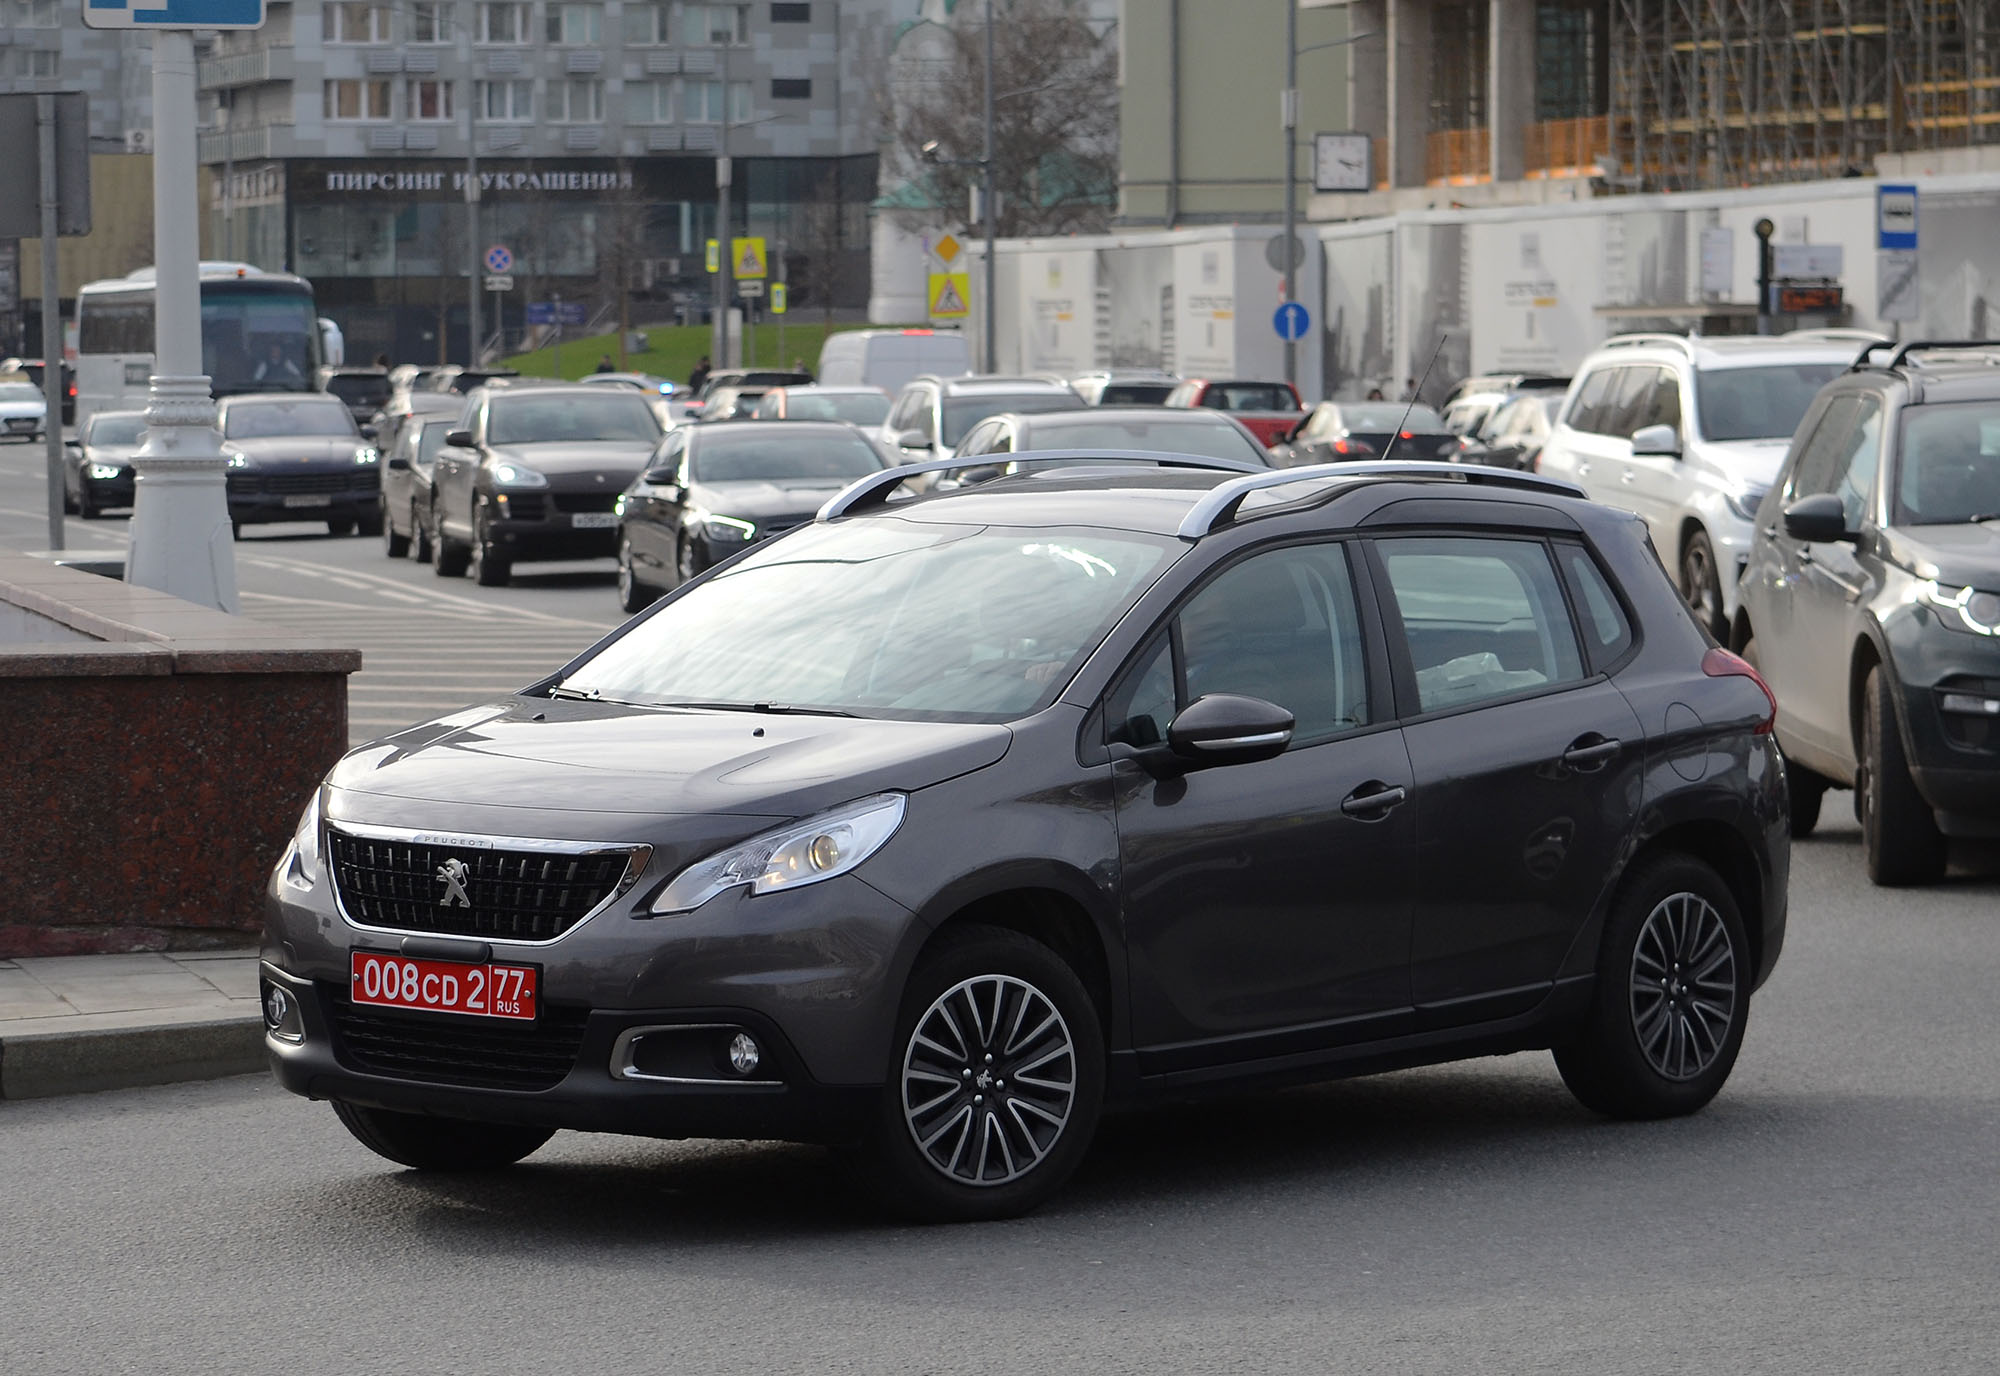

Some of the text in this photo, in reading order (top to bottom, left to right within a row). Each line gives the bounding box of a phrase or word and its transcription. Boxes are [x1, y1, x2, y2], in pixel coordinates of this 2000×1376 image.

[326, 172, 446, 190] ПИРСИНГ
[481, 172, 633, 190] УКРАШЕНИЯ
[424, 835, 485, 846] PEUGEOT
[494, 968, 525, 1001] 77
[496, 1000, 520, 1014] RUS
